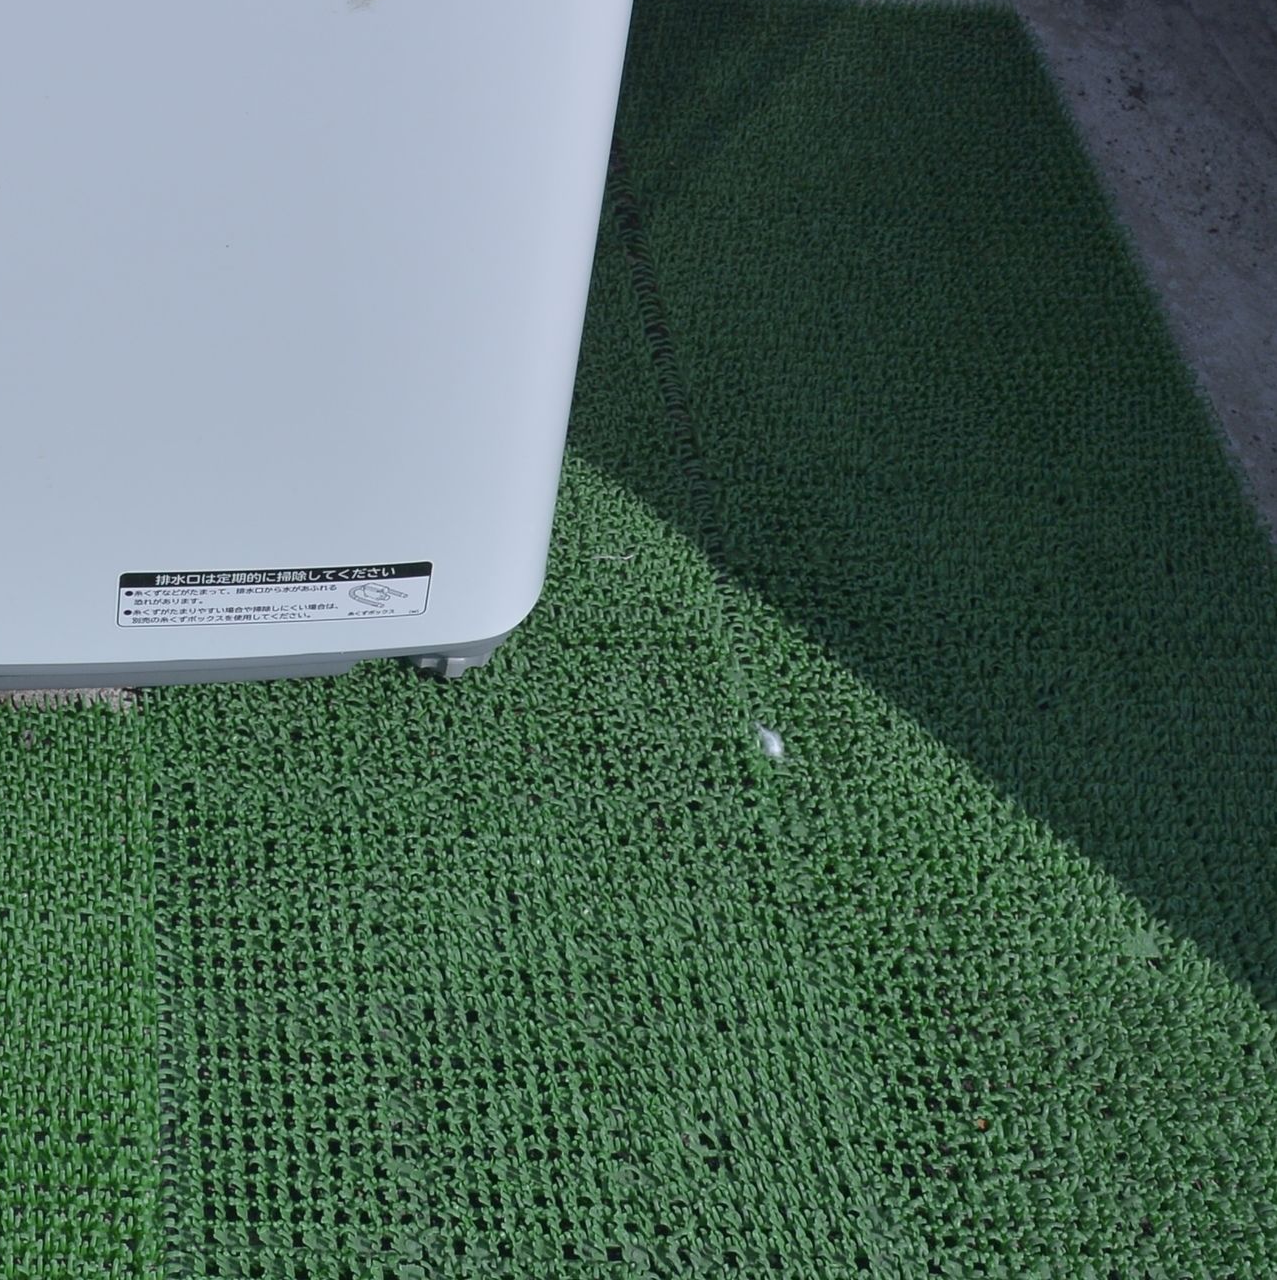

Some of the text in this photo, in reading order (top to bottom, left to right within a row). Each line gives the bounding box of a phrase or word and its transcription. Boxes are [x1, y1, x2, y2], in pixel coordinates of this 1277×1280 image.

[155, 567, 396, 586] 排水口は定期的に掃除してください
